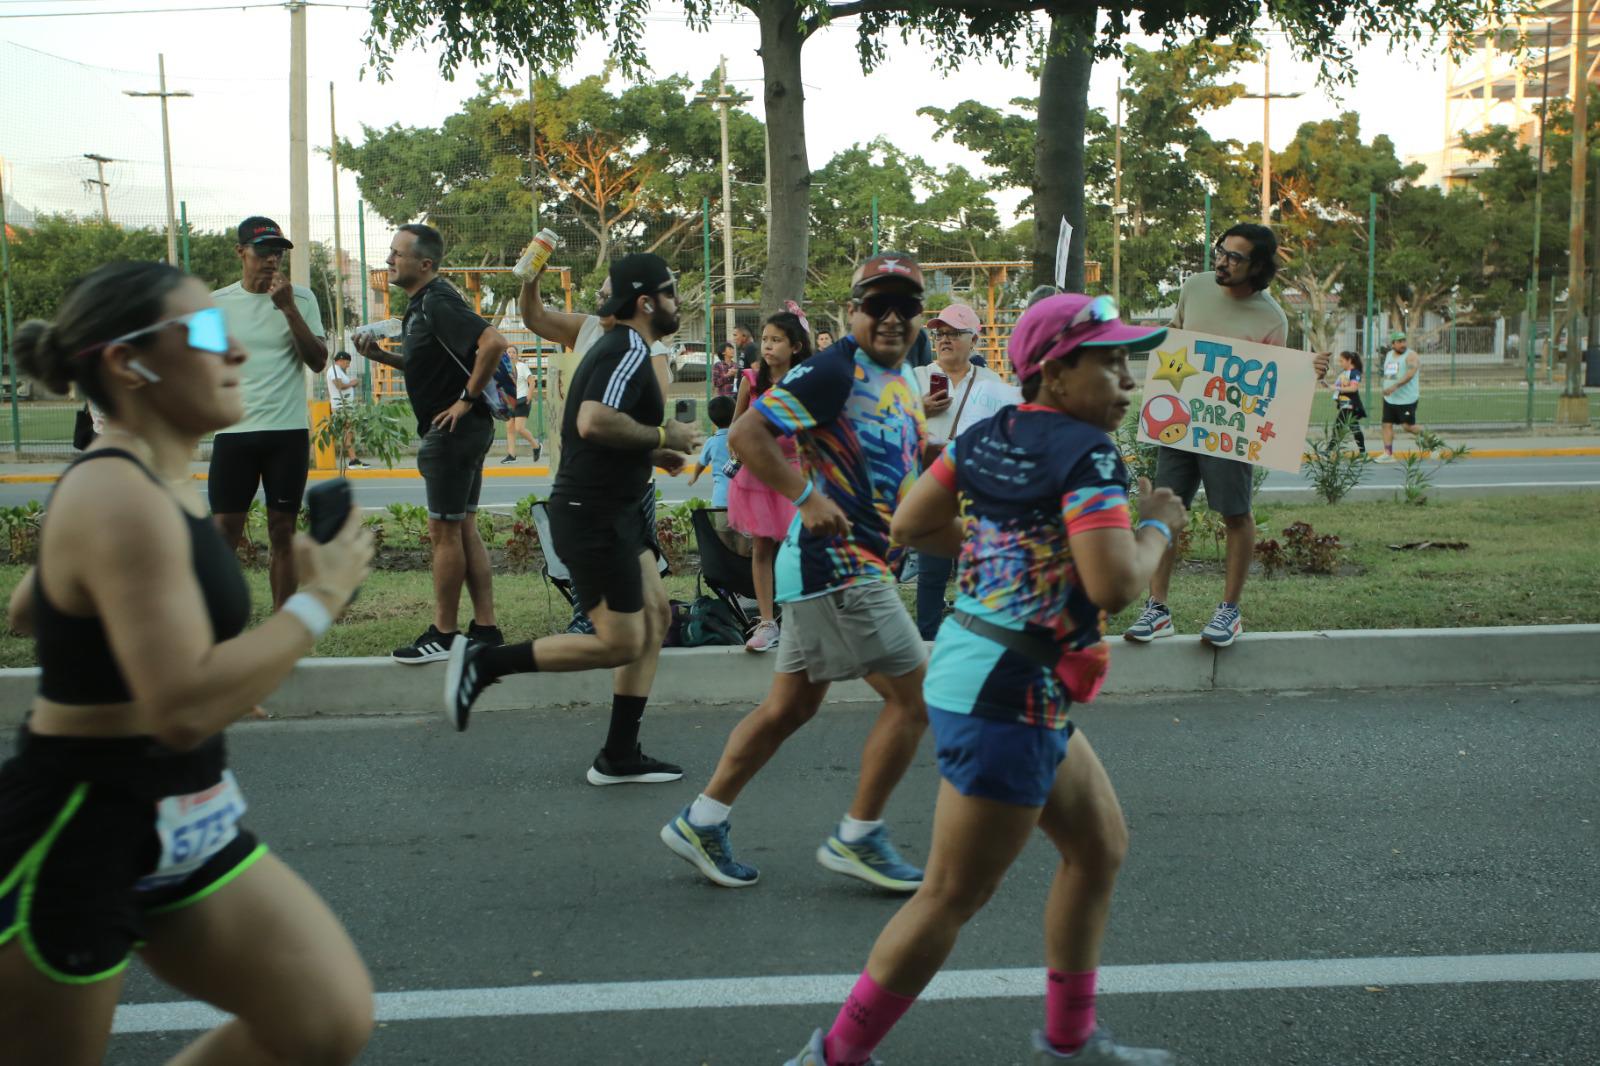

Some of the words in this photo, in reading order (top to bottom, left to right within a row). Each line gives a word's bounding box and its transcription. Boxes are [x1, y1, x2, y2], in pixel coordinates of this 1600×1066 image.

[1194, 340, 1278, 398] TOCA
[1189, 398, 1246, 432] PARA
[1192, 427, 1263, 461] PODER
